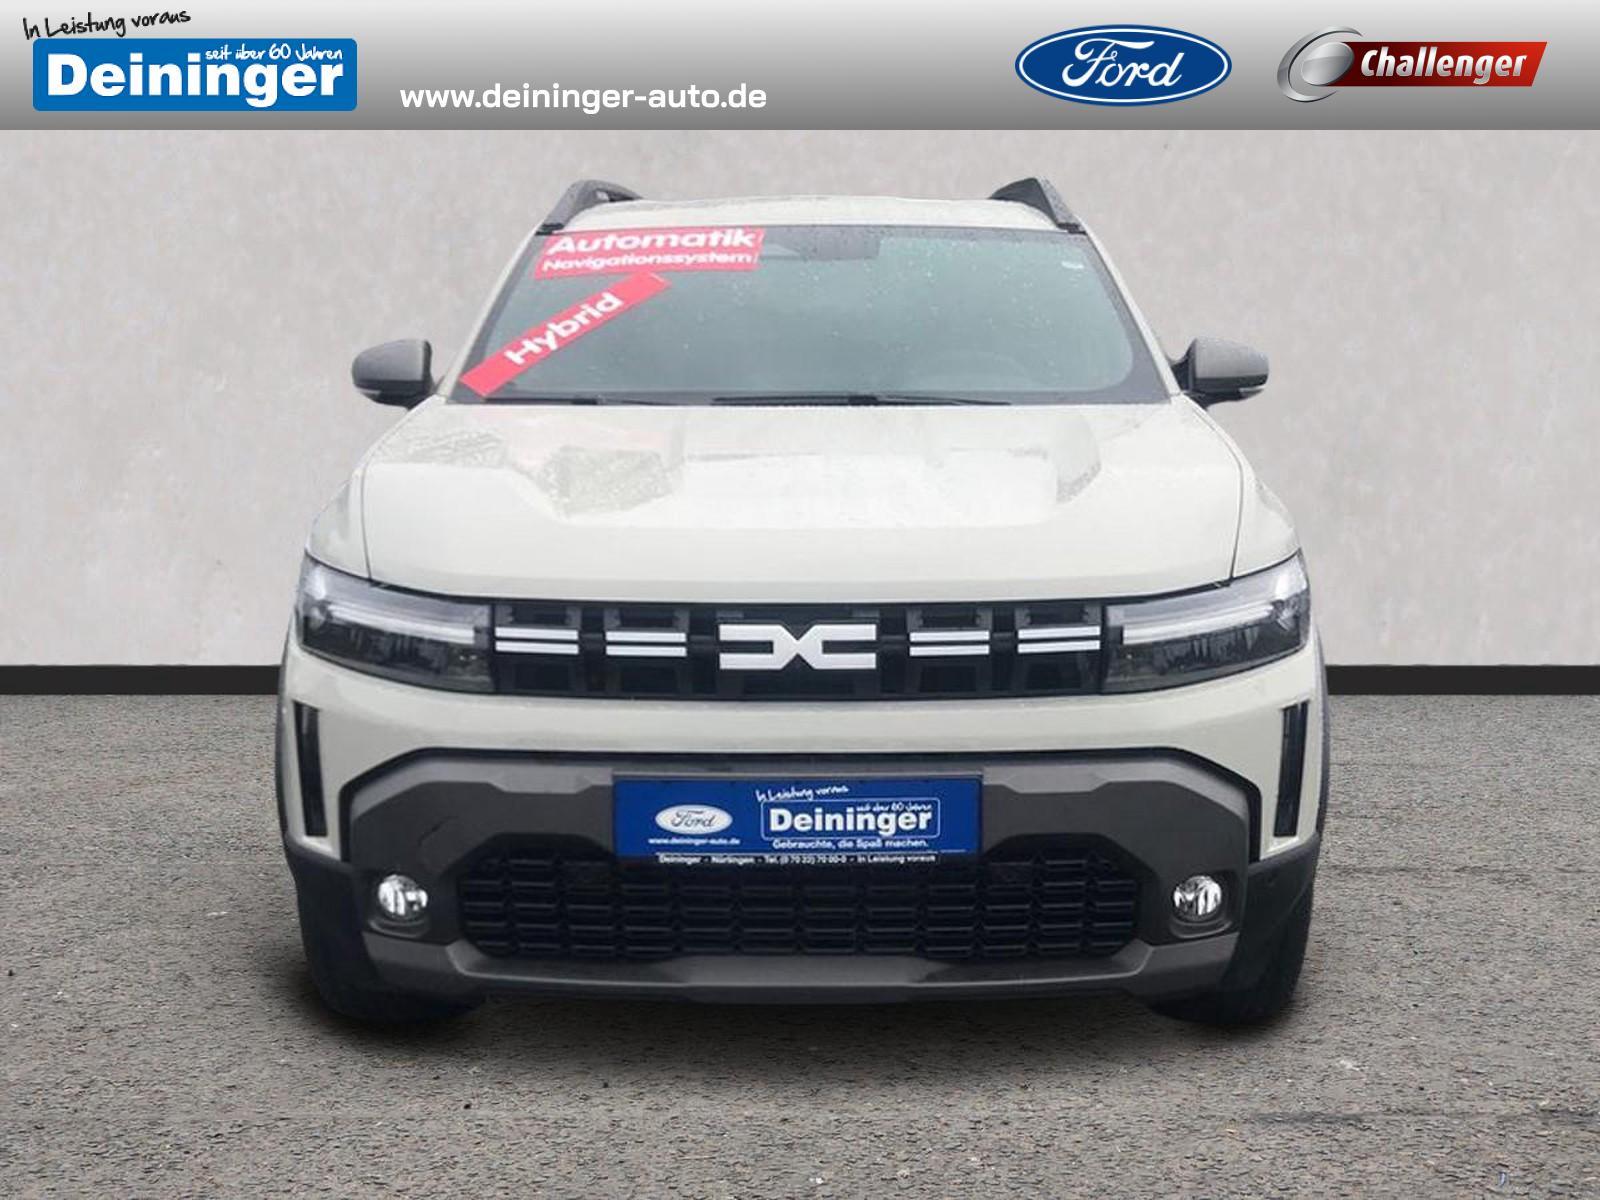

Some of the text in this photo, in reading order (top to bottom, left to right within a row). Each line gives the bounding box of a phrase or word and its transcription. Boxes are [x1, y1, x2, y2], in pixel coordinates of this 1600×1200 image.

[546, 228, 757, 255] Automatik
[541, 252, 752, 272] Navigationssystem
[504, 291, 624, 366] Hybrid
[671, 810, 716, 827] Ford
[769, 807, 932, 836] Deininger
[772, 839, 836, 850] Gebrauchte,
[837, 839, 854, 849] die
[885, 839, 929, 848] machen.
